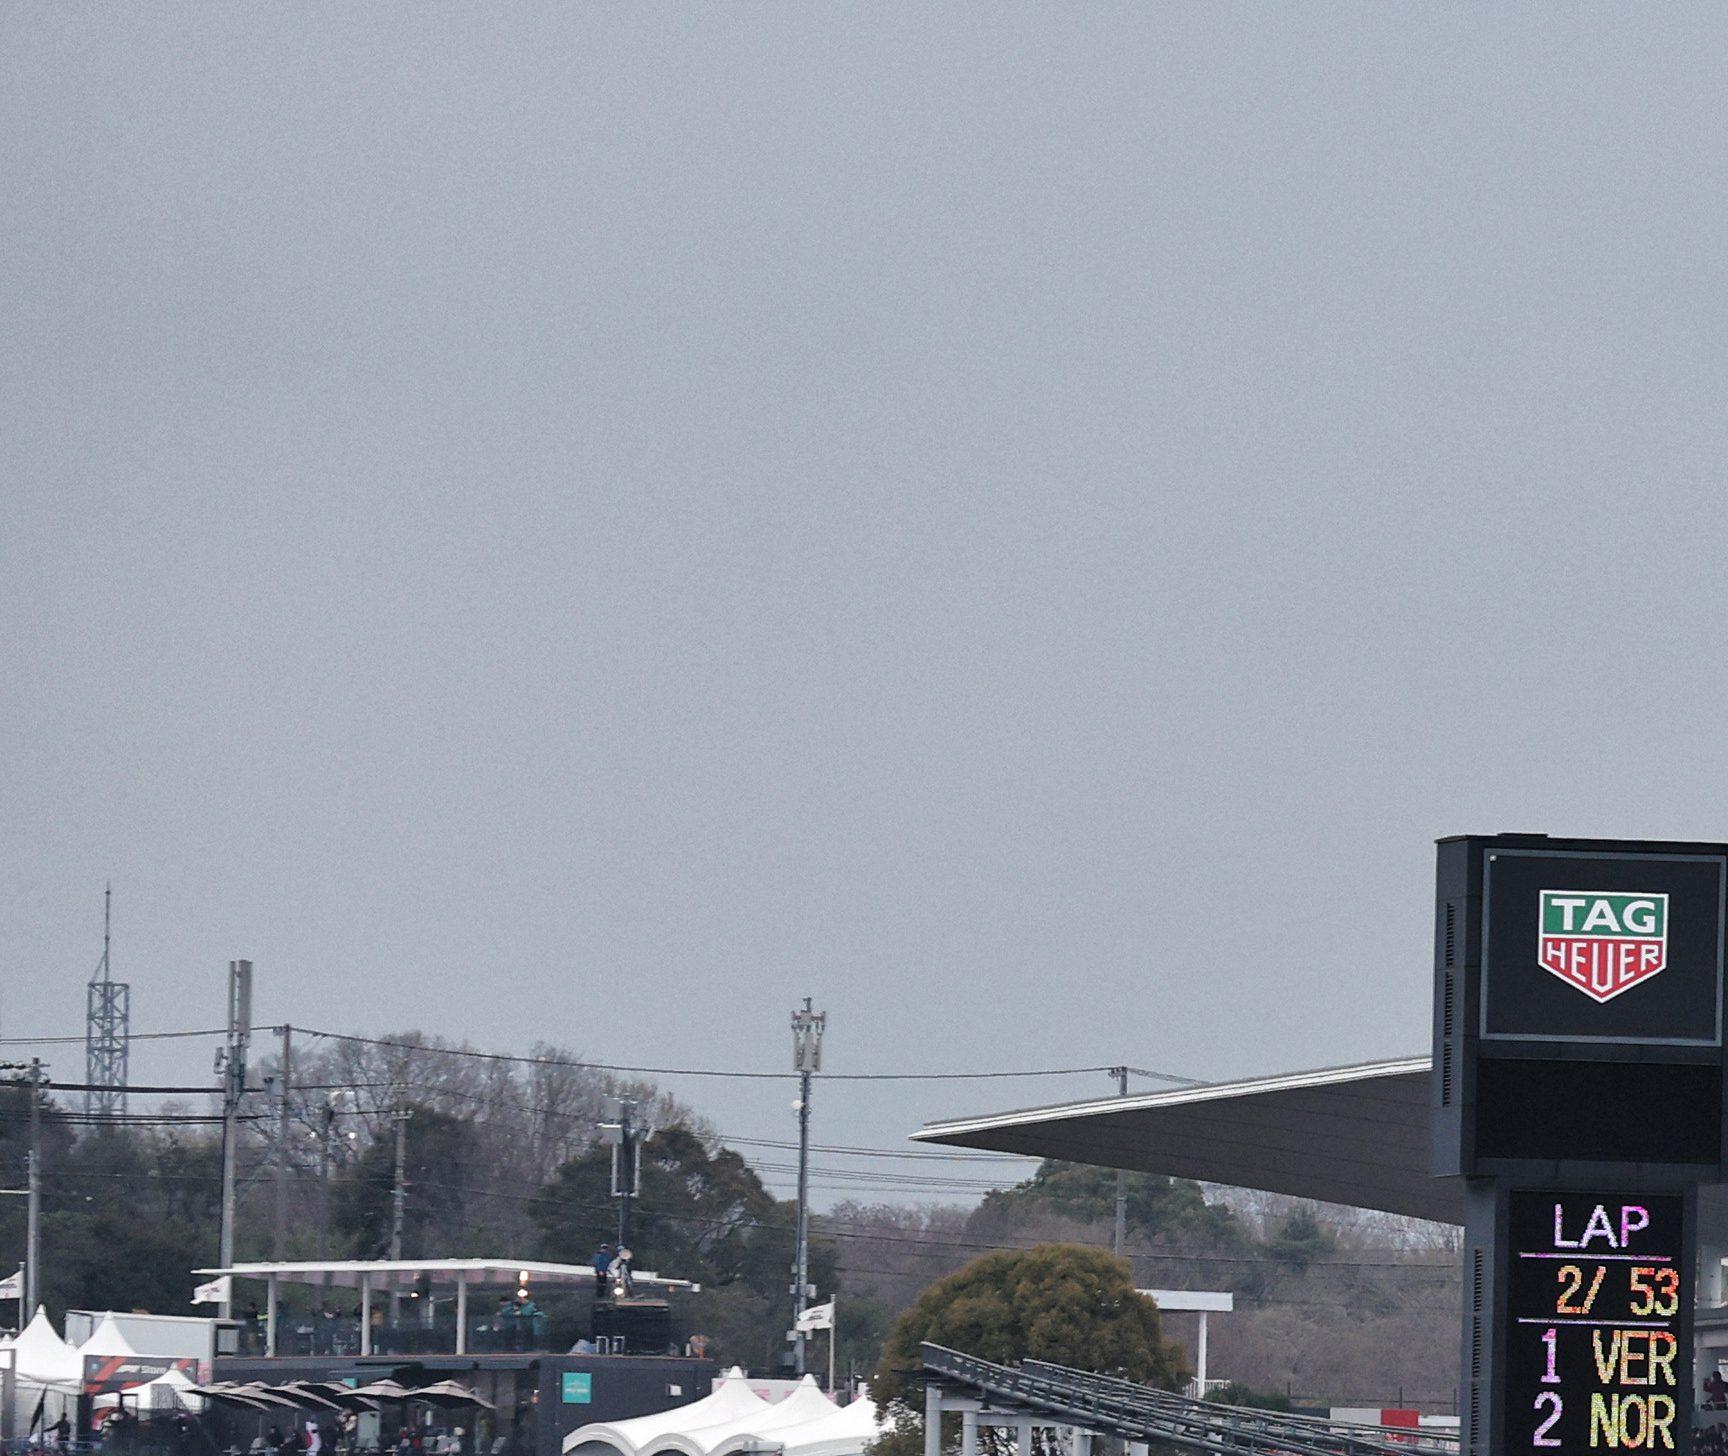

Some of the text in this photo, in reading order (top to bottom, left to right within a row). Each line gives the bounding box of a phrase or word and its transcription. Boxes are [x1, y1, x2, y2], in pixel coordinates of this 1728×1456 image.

[1551, 899, 1656, 933] TAG
[1546, 940, 1660, 990] HEUER
[1555, 1204, 1649, 1248] LAP
[1630, 1266, 1679, 1316] 53
[1541, 1329, 1676, 1385] 1 VER
[1534, 1394, 1675, 1448] 2 NOR
